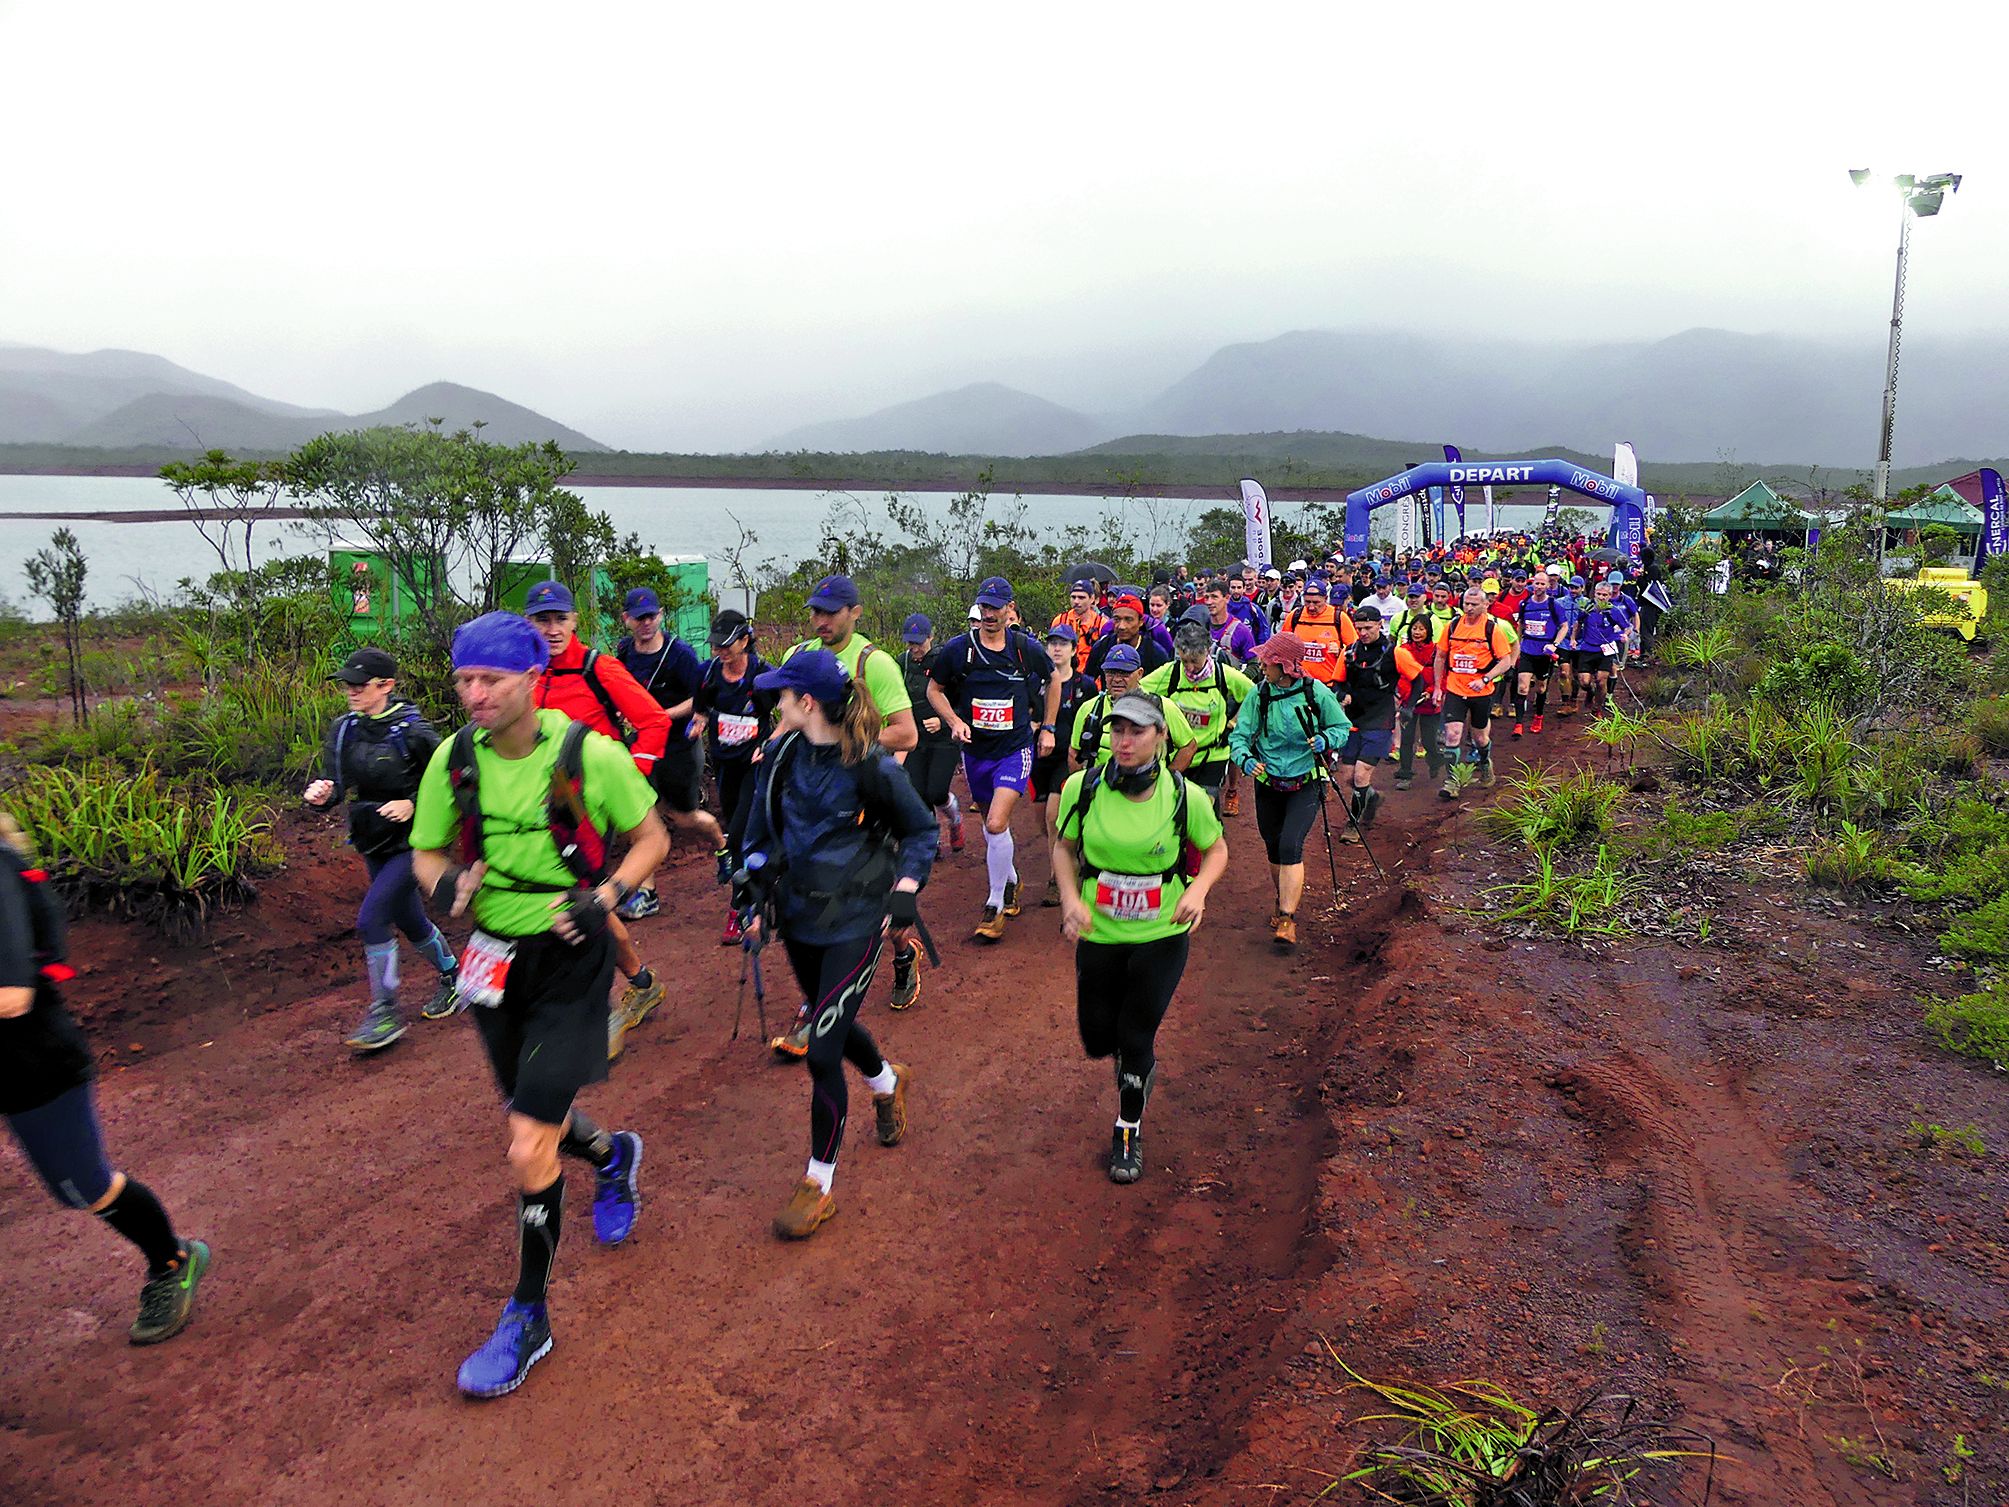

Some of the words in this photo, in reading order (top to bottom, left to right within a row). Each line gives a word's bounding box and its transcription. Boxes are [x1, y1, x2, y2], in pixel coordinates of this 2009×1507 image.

[1449, 467, 1534, 482] DEPART
[1569, 470, 1620, 499] Mobil
[1365, 476, 1412, 506] Mobil
[979, 708, 1005, 721] 27C
[1109, 888, 1150, 912] 10A
